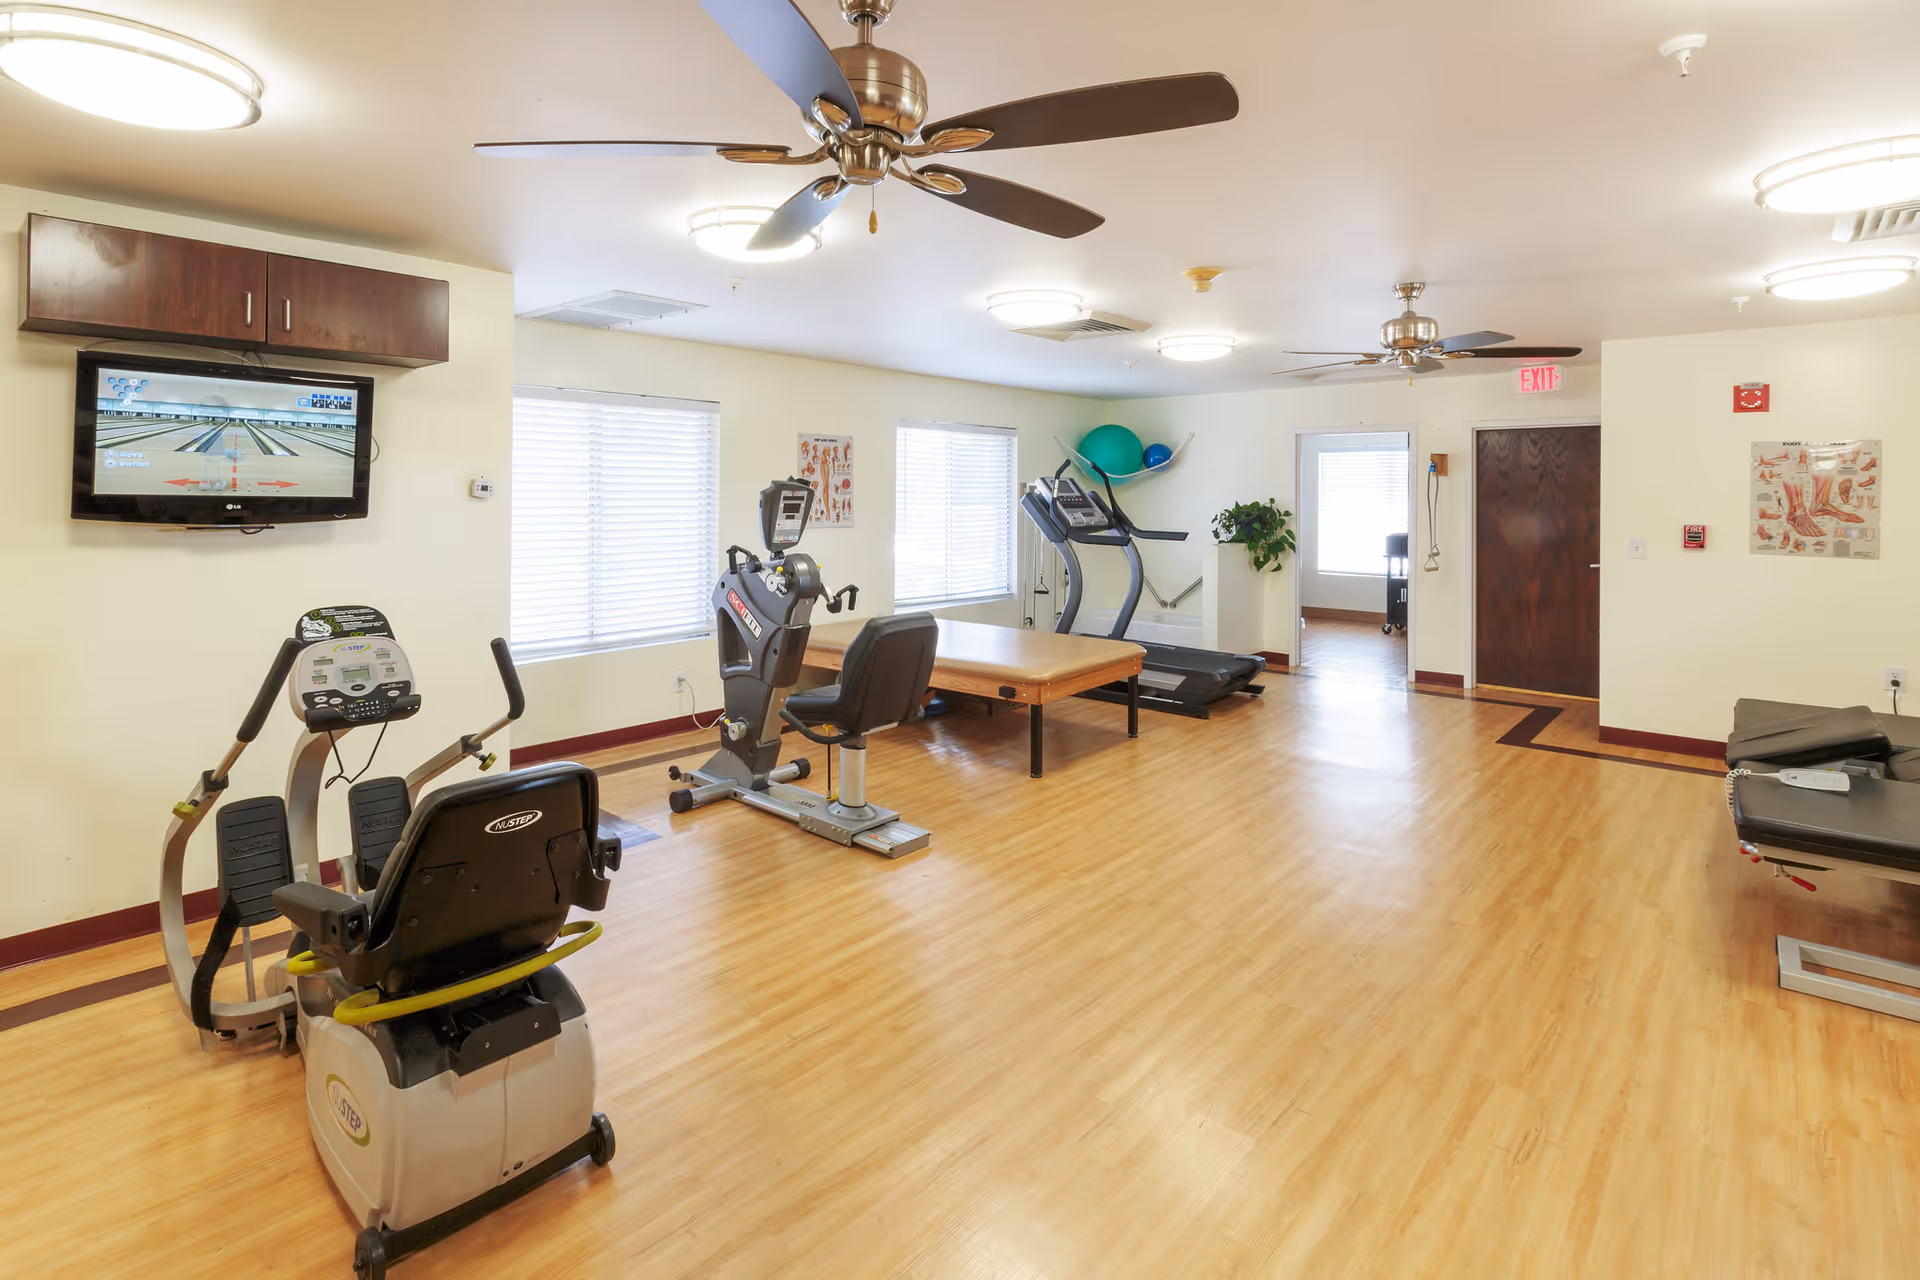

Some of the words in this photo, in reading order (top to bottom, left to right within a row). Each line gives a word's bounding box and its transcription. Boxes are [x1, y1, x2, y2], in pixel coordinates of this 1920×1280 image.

[1521, 366, 1556, 392] EXIT
[729, 592, 761, 632] SCIFIT
[495, 814, 533, 831] NUSTEP
